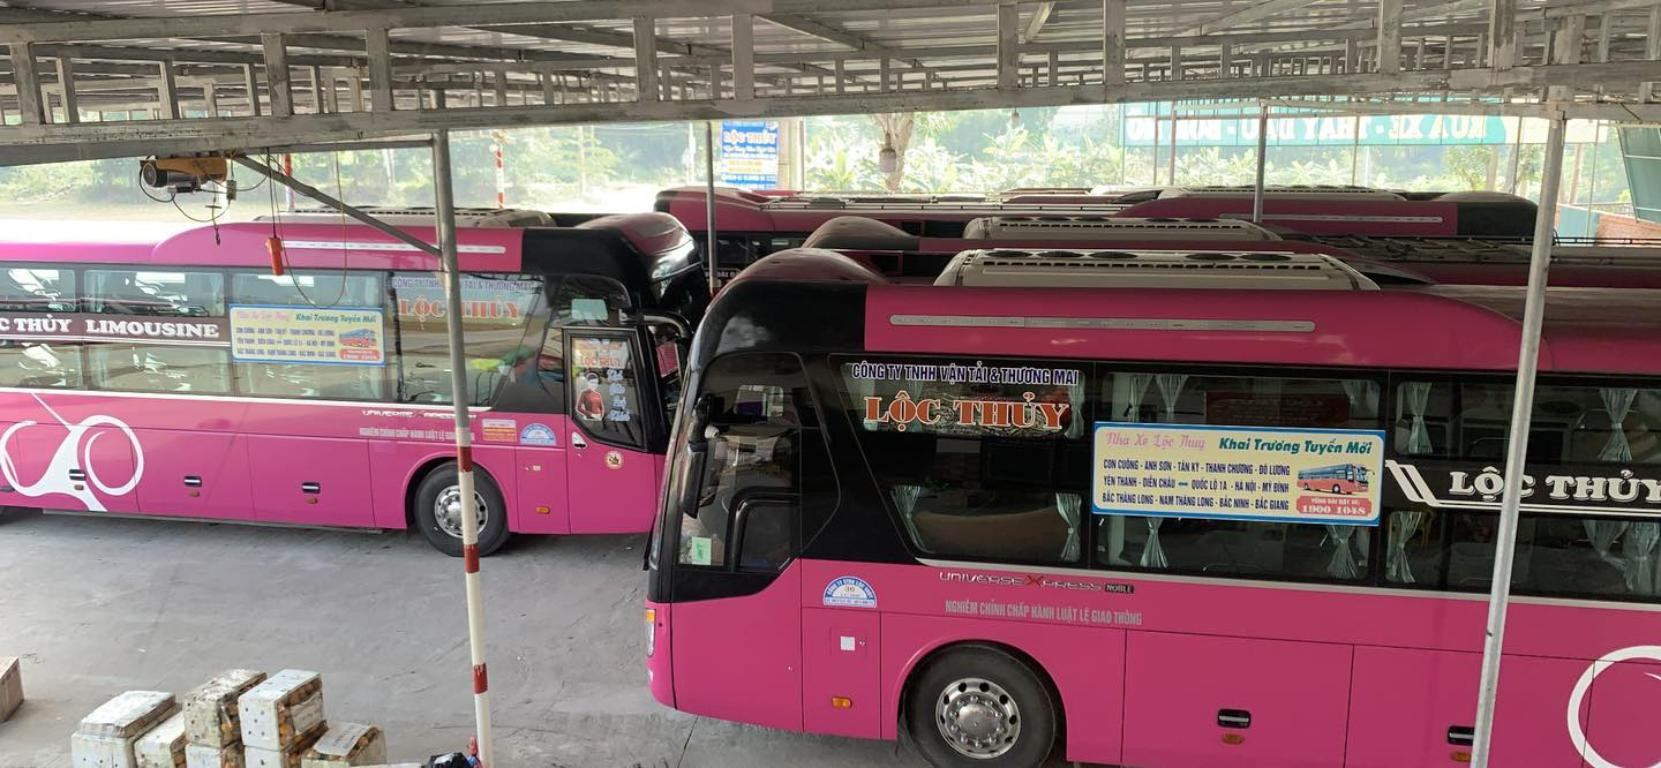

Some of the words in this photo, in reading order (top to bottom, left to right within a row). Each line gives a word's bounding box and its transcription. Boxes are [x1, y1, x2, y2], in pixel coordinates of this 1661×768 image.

[399, 295, 446, 321] LỘC
[14, 314, 72, 332] THỦY
[86, 319, 219, 338] LIMOUSINE
[852, 360, 885, 379] CÔNG
[887, 363, 902, 380] TY
[904, 364, 937, 381] TNHH
[940, 362, 967, 385] VẬN
[968, 360, 988, 383] TẢI
[990, 367, 1000, 383] &
[1001, 367, 1051, 384] THƯƠNG
[864, 390, 941, 432] LỘC
[953, 391, 1069, 430] THỦY
[1219, 438, 1250, 450] Khai
[1545, 469, 1661, 504] THỦY
[1138, 494, 1153, 504] LONG
[1197, 497, 1213, 507] LONG
[1303, 505, 1331, 513] 1900
[1091, 609, 1112, 623] GIAO
